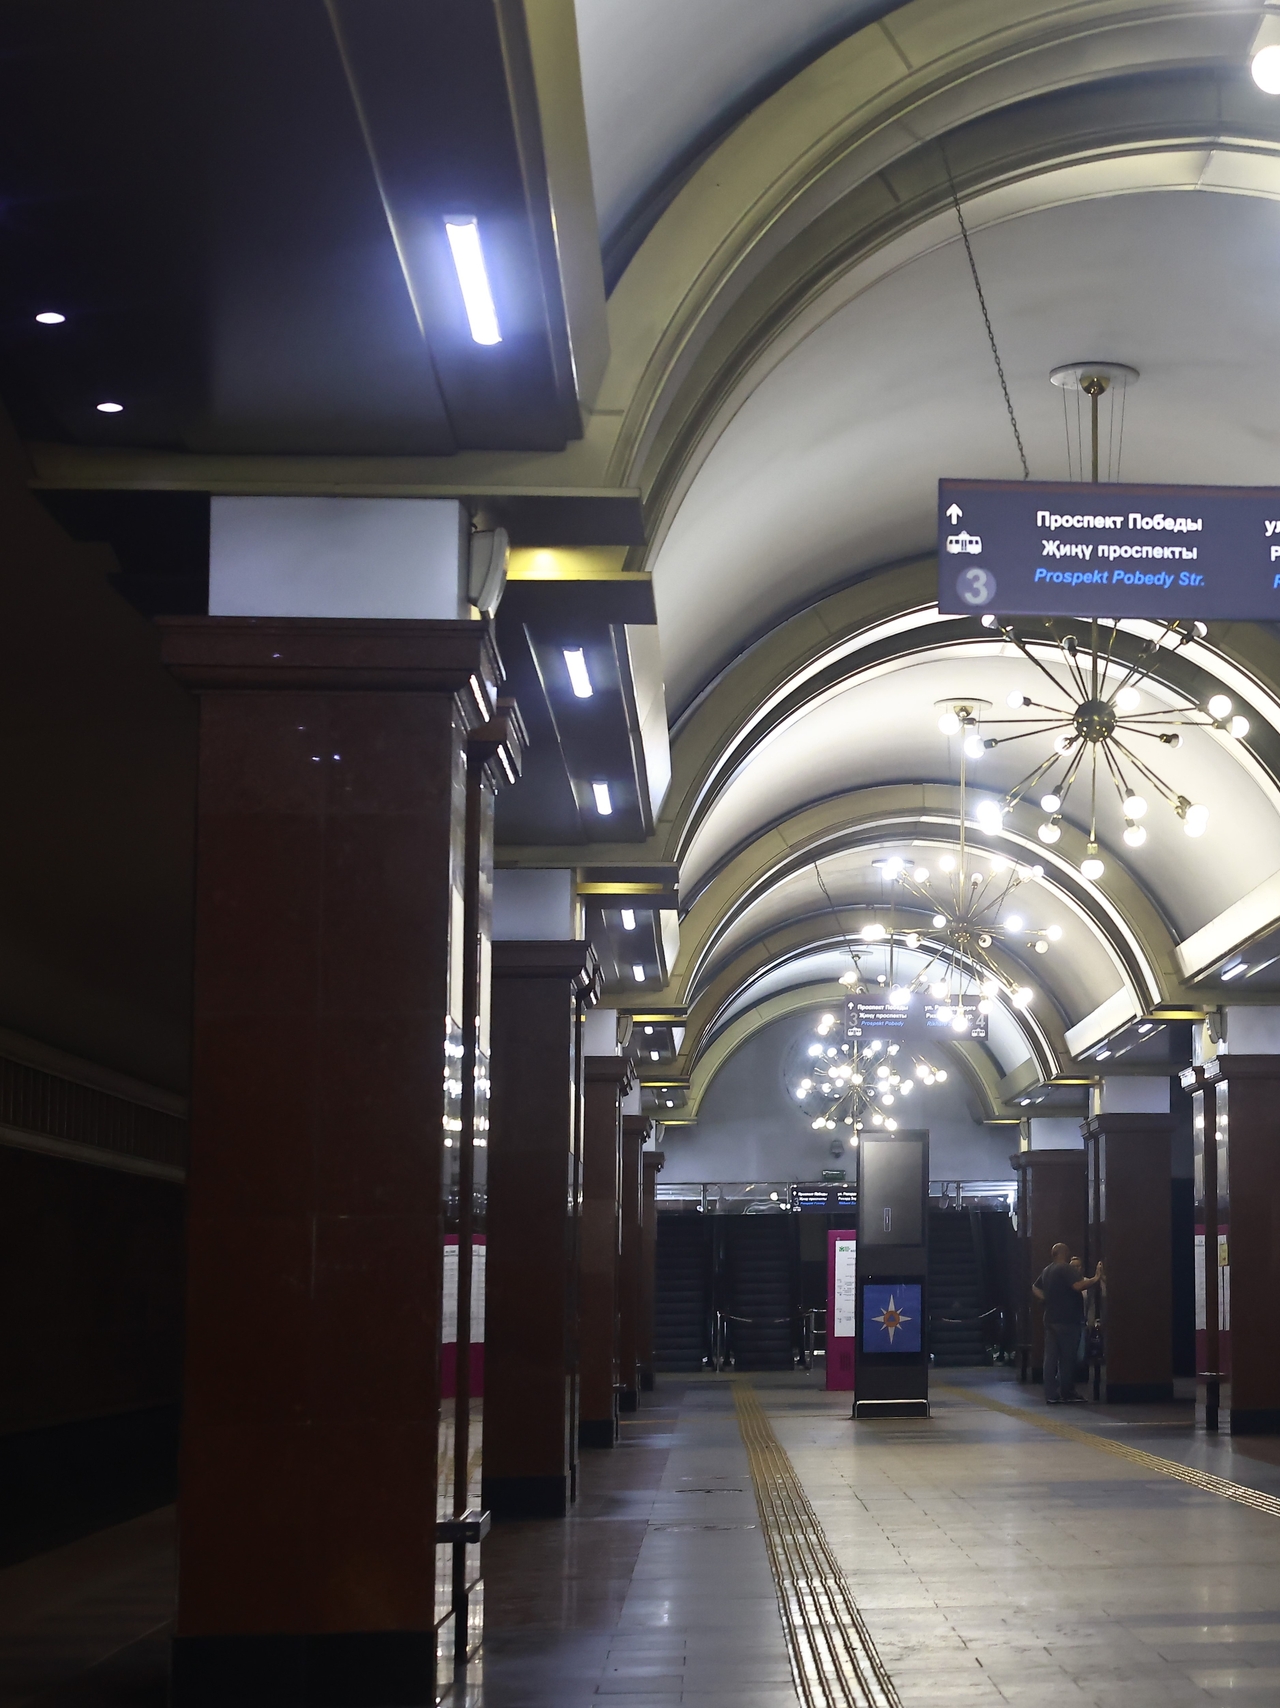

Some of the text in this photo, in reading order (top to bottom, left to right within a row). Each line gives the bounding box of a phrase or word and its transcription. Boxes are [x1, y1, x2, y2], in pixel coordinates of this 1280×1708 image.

[1036, 510, 1203, 533] Проспект Победы
[1041, 539, 1198, 562] Җиңү проспекты
[964, 568, 989, 605] 3
[1033, 567, 1205, 590] Prospekt Pobedy Str.
[849, 1012, 858, 1026] 3
[976, 1013, 986, 1028] 4
